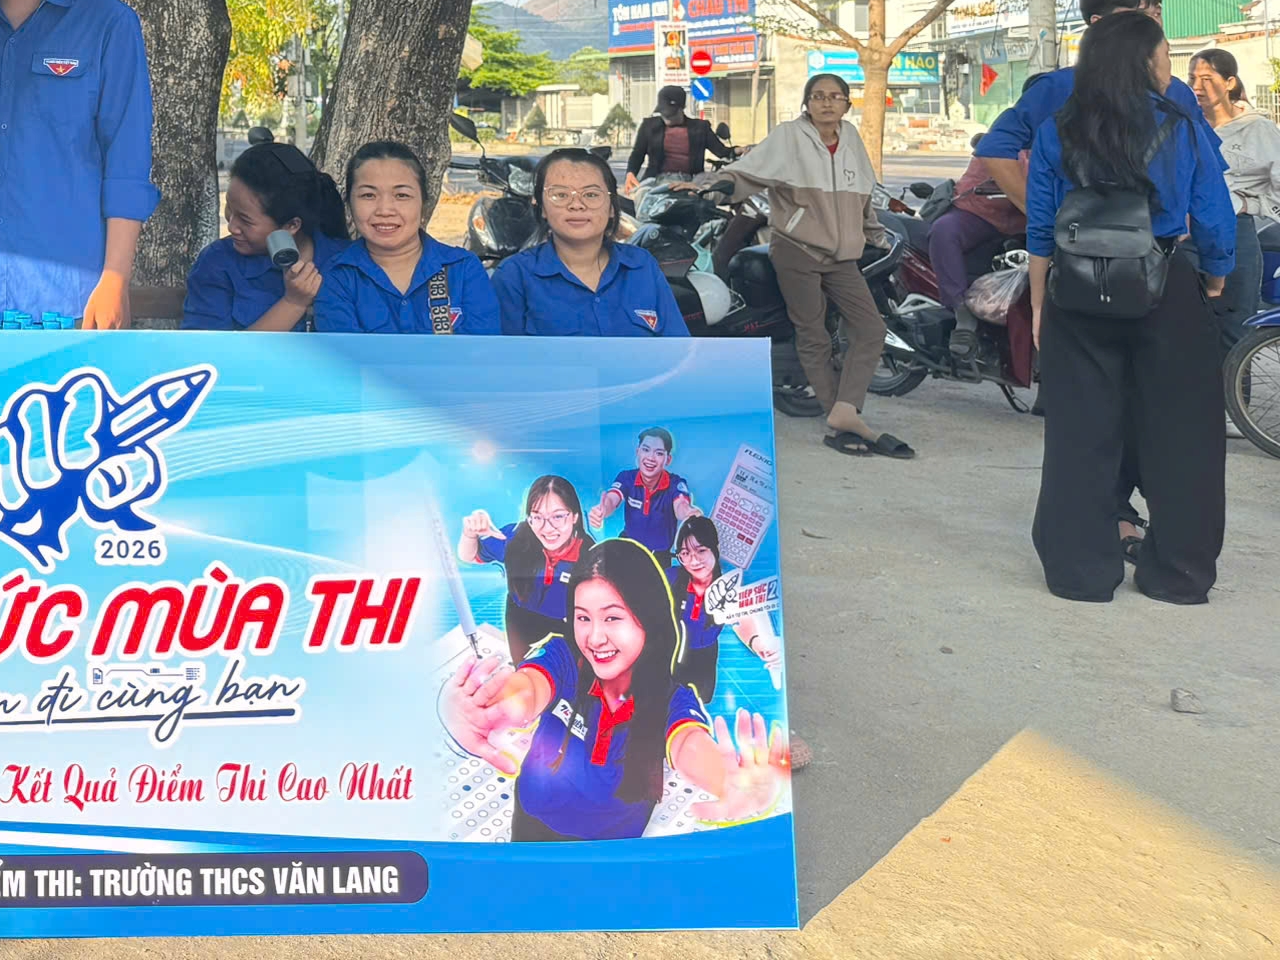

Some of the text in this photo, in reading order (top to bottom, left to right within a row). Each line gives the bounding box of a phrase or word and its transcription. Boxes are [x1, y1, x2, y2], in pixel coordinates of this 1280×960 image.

[101, 539, 161, 559] 2026
[91, 566, 285, 656] MÙA
[308, 577, 422, 647] THI
[37, 672, 83, 725] đi
[96, 681, 201, 742] cùng
[215, 659, 301, 705] bạn
[0, 764, 54, 805] Kết
[63, 763, 119, 812] Quả
[128, 763, 206, 803] Điểm
[216, 763, 269, 802] Thi
[278, 762, 330, 802] Cao
[339, 761, 415, 802] Nhất
[34, 869, 82, 897] THI:
[89, 862, 193, 897] TRƯỜNG
[200, 867, 266, 896] THCS
[272, 862, 325, 895] VĂN
[333, 866, 400, 894] LANG
